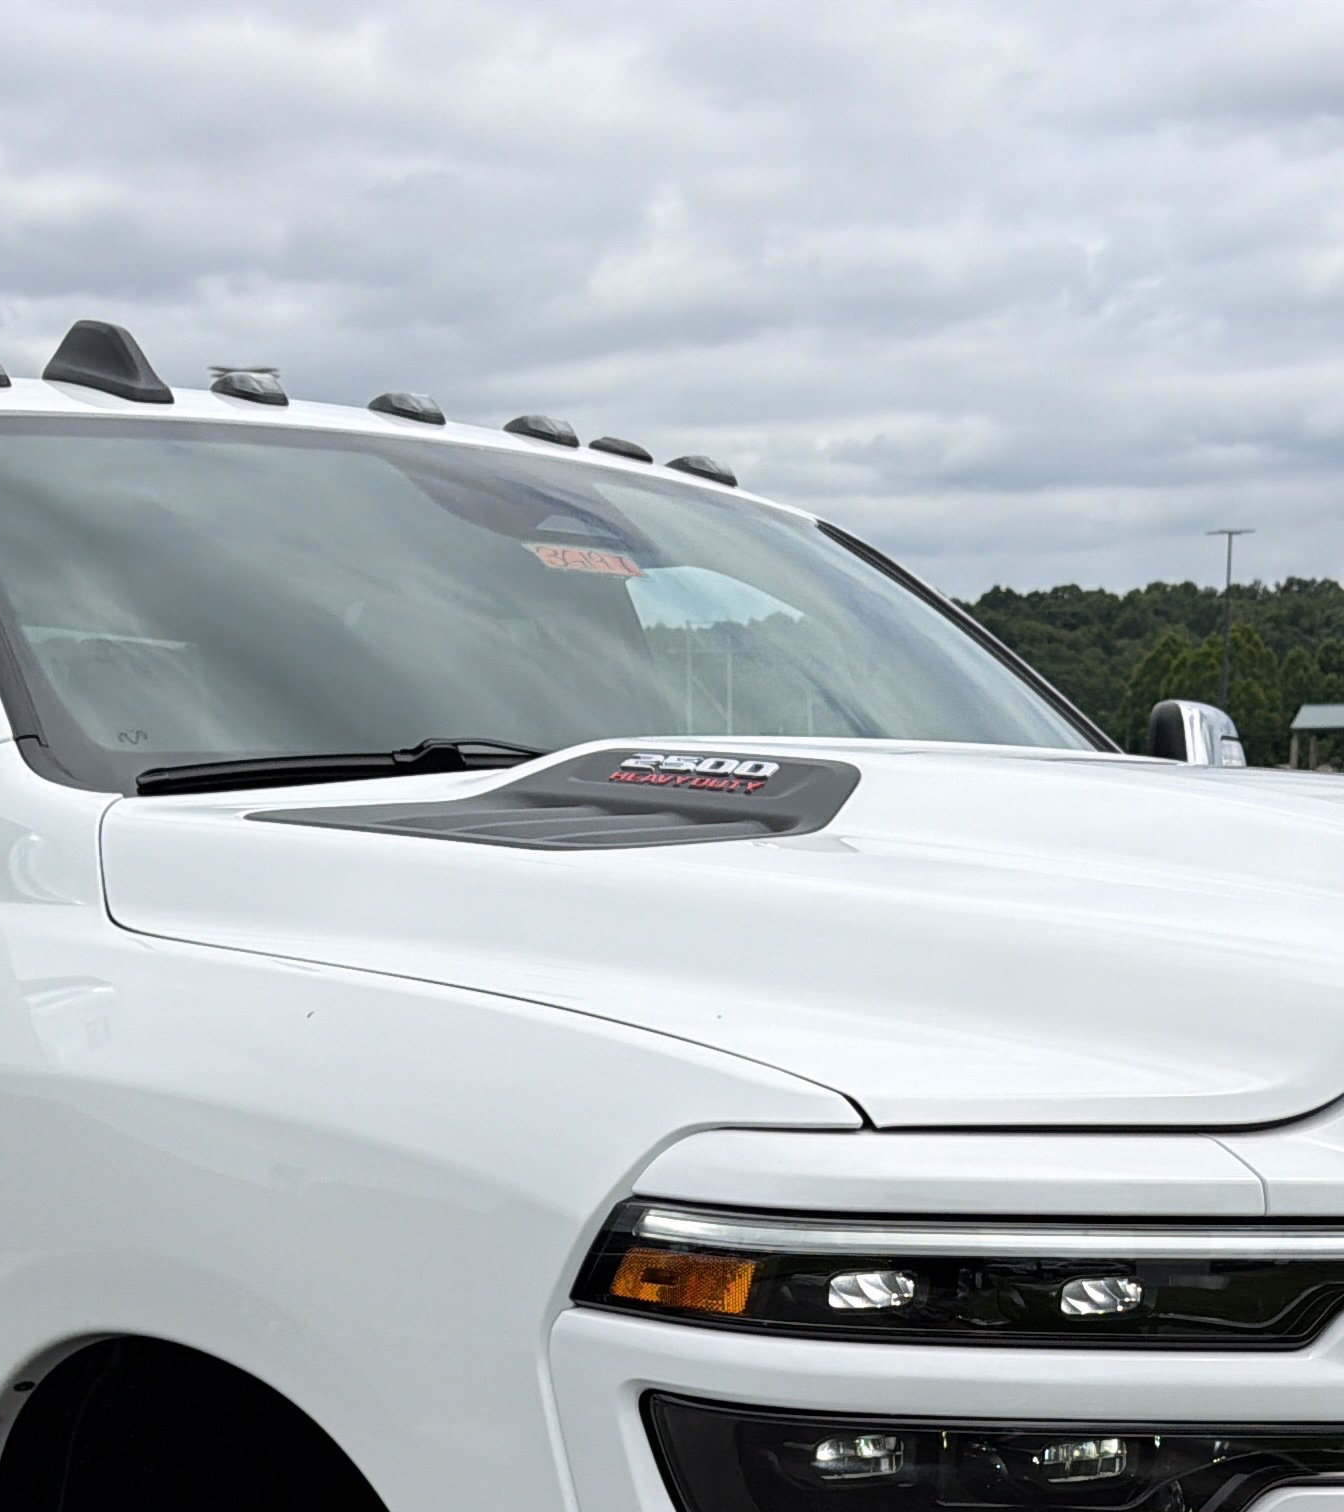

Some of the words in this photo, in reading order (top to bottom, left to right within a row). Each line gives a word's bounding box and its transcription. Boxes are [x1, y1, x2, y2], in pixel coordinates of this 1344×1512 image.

[620, 753, 781, 780] 2500
[609, 771, 691, 787] HEAVY
[687, 777, 766, 795] DUTY
